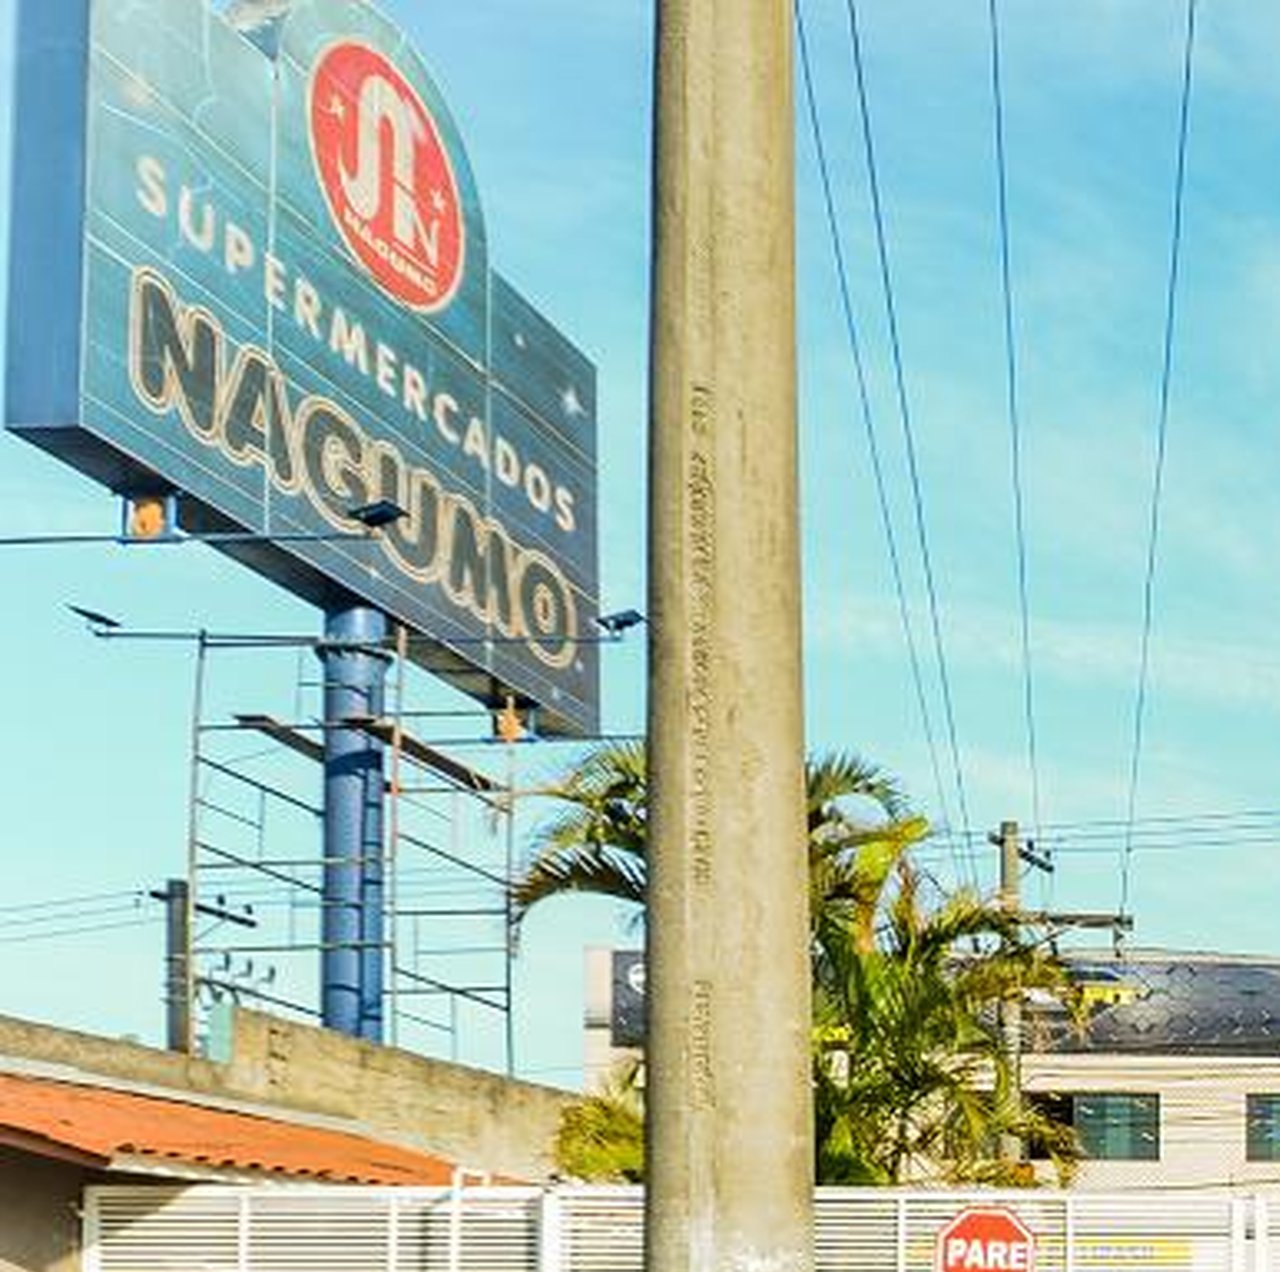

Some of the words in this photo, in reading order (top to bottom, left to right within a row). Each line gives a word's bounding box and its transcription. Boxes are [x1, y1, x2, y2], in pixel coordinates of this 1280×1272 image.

[128, 266, 577, 669] NAGUMO
[134, 155, 578, 533] SUPERMERCADOS
[946, 1238, 1028, 1270] PARE
